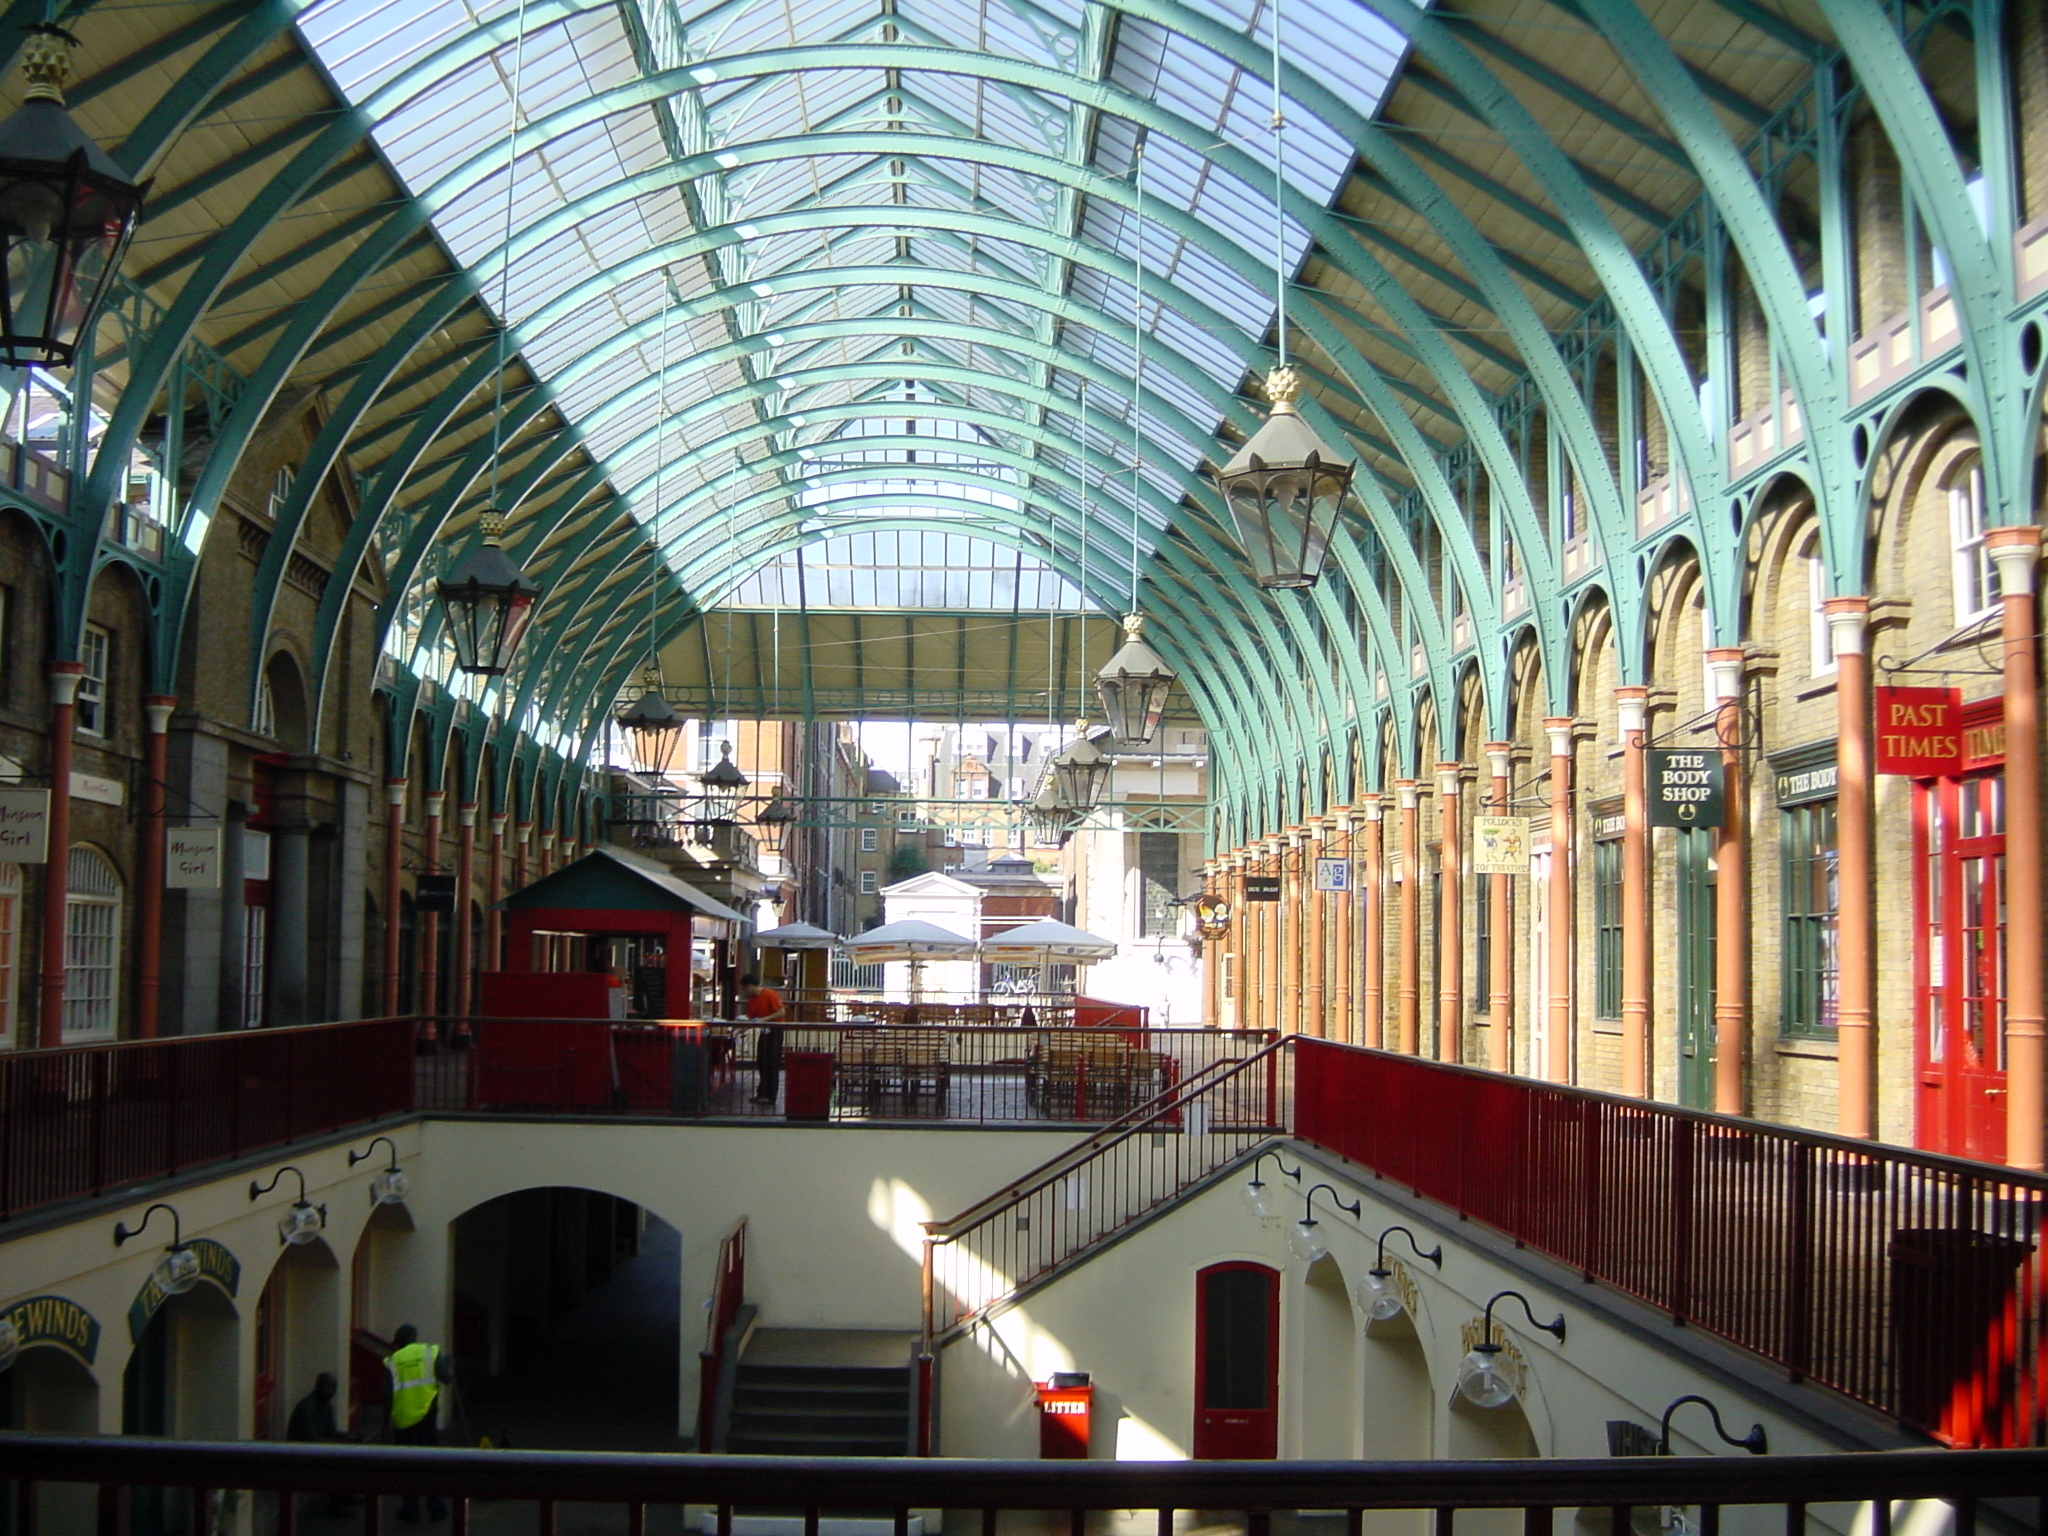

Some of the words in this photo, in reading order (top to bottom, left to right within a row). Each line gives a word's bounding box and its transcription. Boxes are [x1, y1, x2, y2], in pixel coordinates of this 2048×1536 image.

[1890, 704, 1948, 727] PAST
[1881, 735, 1957, 758] TIMES
[1964, 724, 2006, 760] TIME
[1666, 755, 1704, 768] THE
[1661, 770, 1712, 785] BODY
[1789, 773, 1810, 794] THE
[1810, 766, 1837, 790] BODY
[1662, 787, 1711, 801] SHOP
[1616, 815, 1626, 831] BO
[0, 830, 30, 845] Girl
[180, 861, 205, 874] Girl
[1044, 1401, 1085, 1414] LITTER
